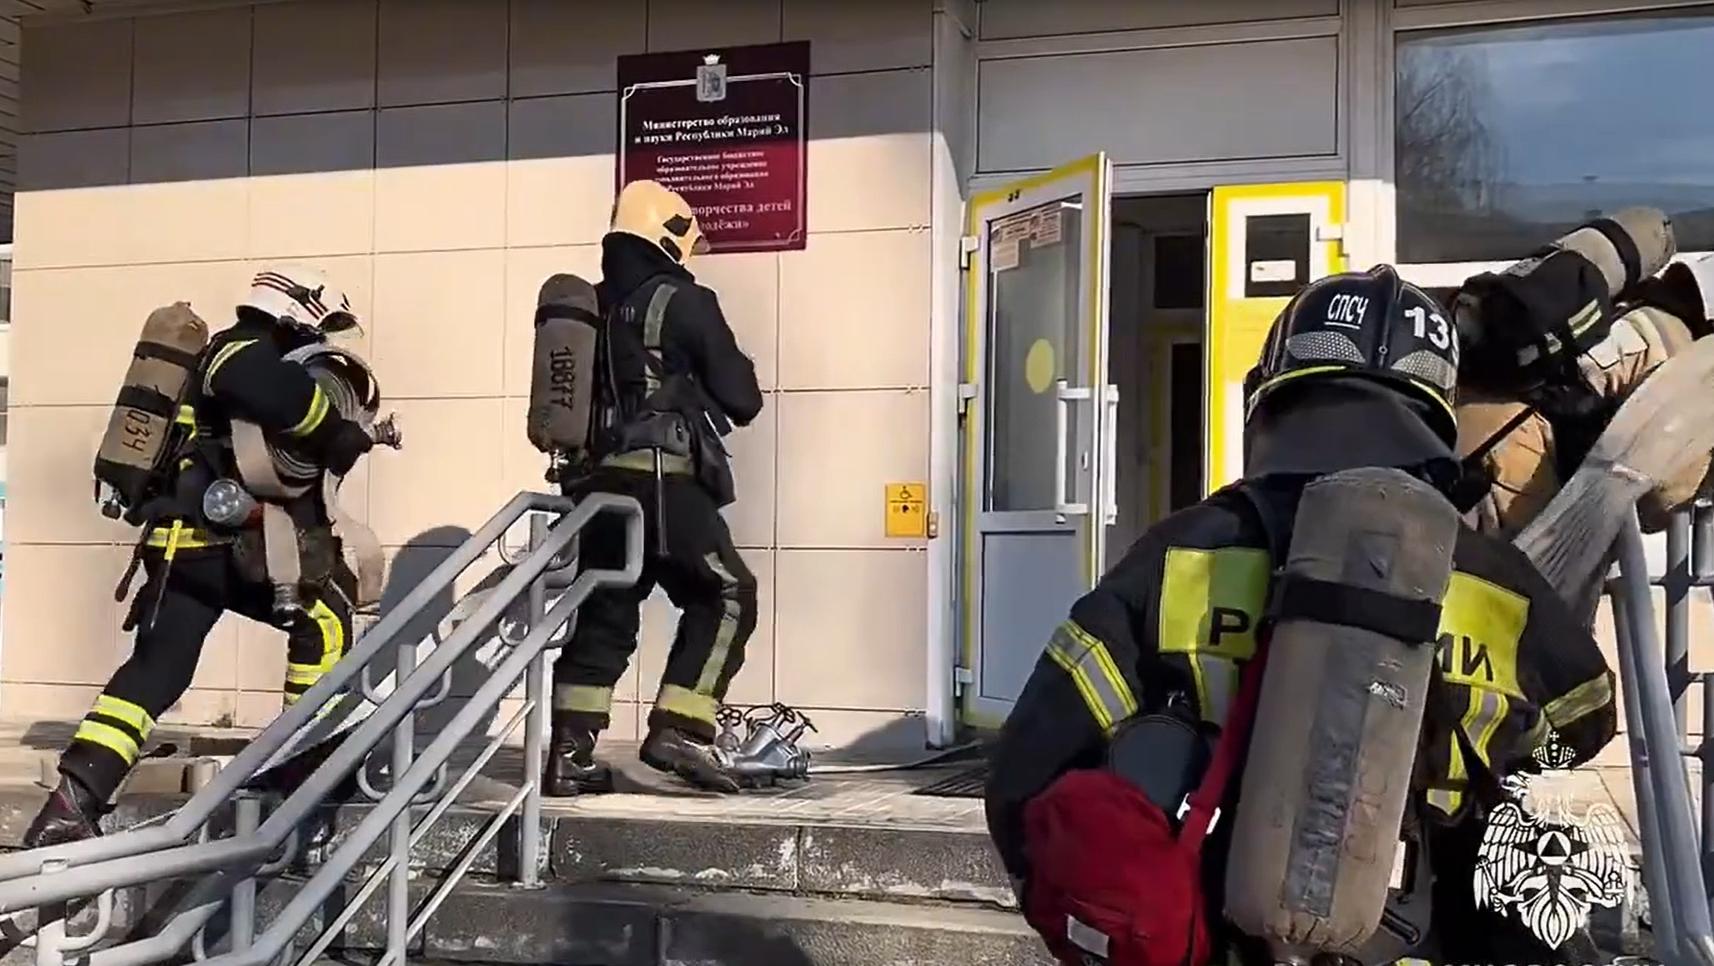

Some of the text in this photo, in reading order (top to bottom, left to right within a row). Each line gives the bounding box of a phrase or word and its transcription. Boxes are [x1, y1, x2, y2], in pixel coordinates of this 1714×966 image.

[643, 114, 780, 131] Министерство образования
[634, 123, 788, 145] и науки Республики Марий Эл
[691, 199, 791, 217] ворчества детей
[1327, 293, 1369, 325] СПСЧ
